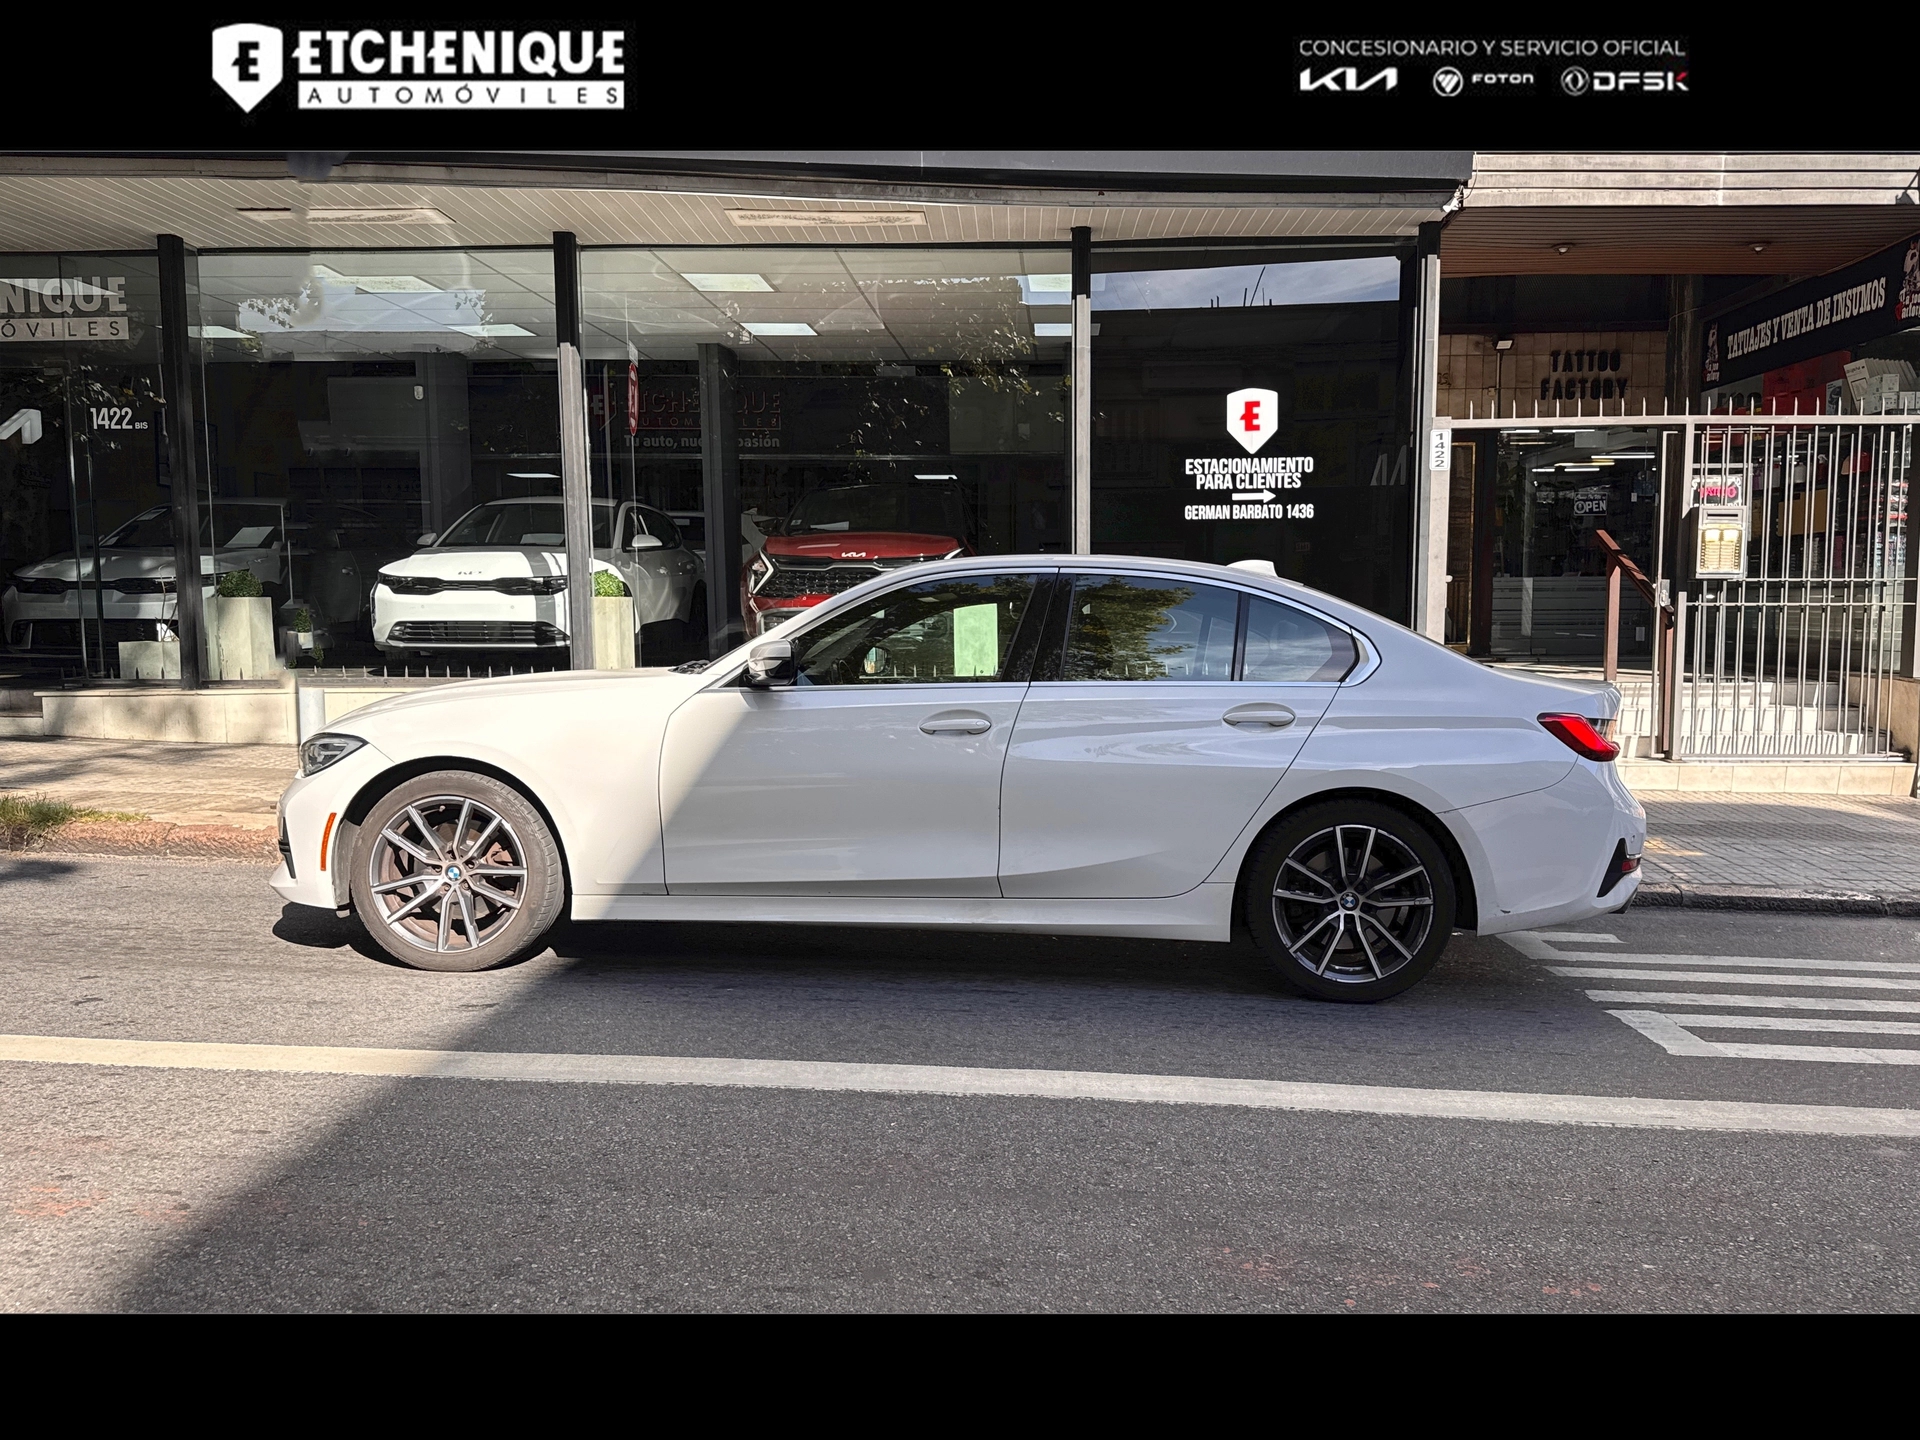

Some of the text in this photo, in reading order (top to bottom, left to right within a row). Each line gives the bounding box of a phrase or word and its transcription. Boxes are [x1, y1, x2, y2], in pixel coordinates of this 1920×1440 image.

[1727, 319, 1771, 360] TATUAJES
[1773, 316, 1781, 344] Y
[1781, 303, 1815, 341] VENTA
[1816, 297, 1831, 329] DE
[1832, 277, 1887, 323] INSUMOS
[1551, 349, 1621, 372] TATTOO
[1541, 377, 1628, 400] FACTORY
[90, 407, 149, 430] 1422 BIS
[643, 436, 679, 449] auto,
[1434, 433, 1445, 467] 1422
[1185, 456, 1314, 475] ESTACIONAMIENTO
[1196, 472, 1302, 490] PARA CLIENTES
[1184, 503, 1315, 520] GERMAN BARBATO 1436
[1574, 500, 1607, 514] OPEN
